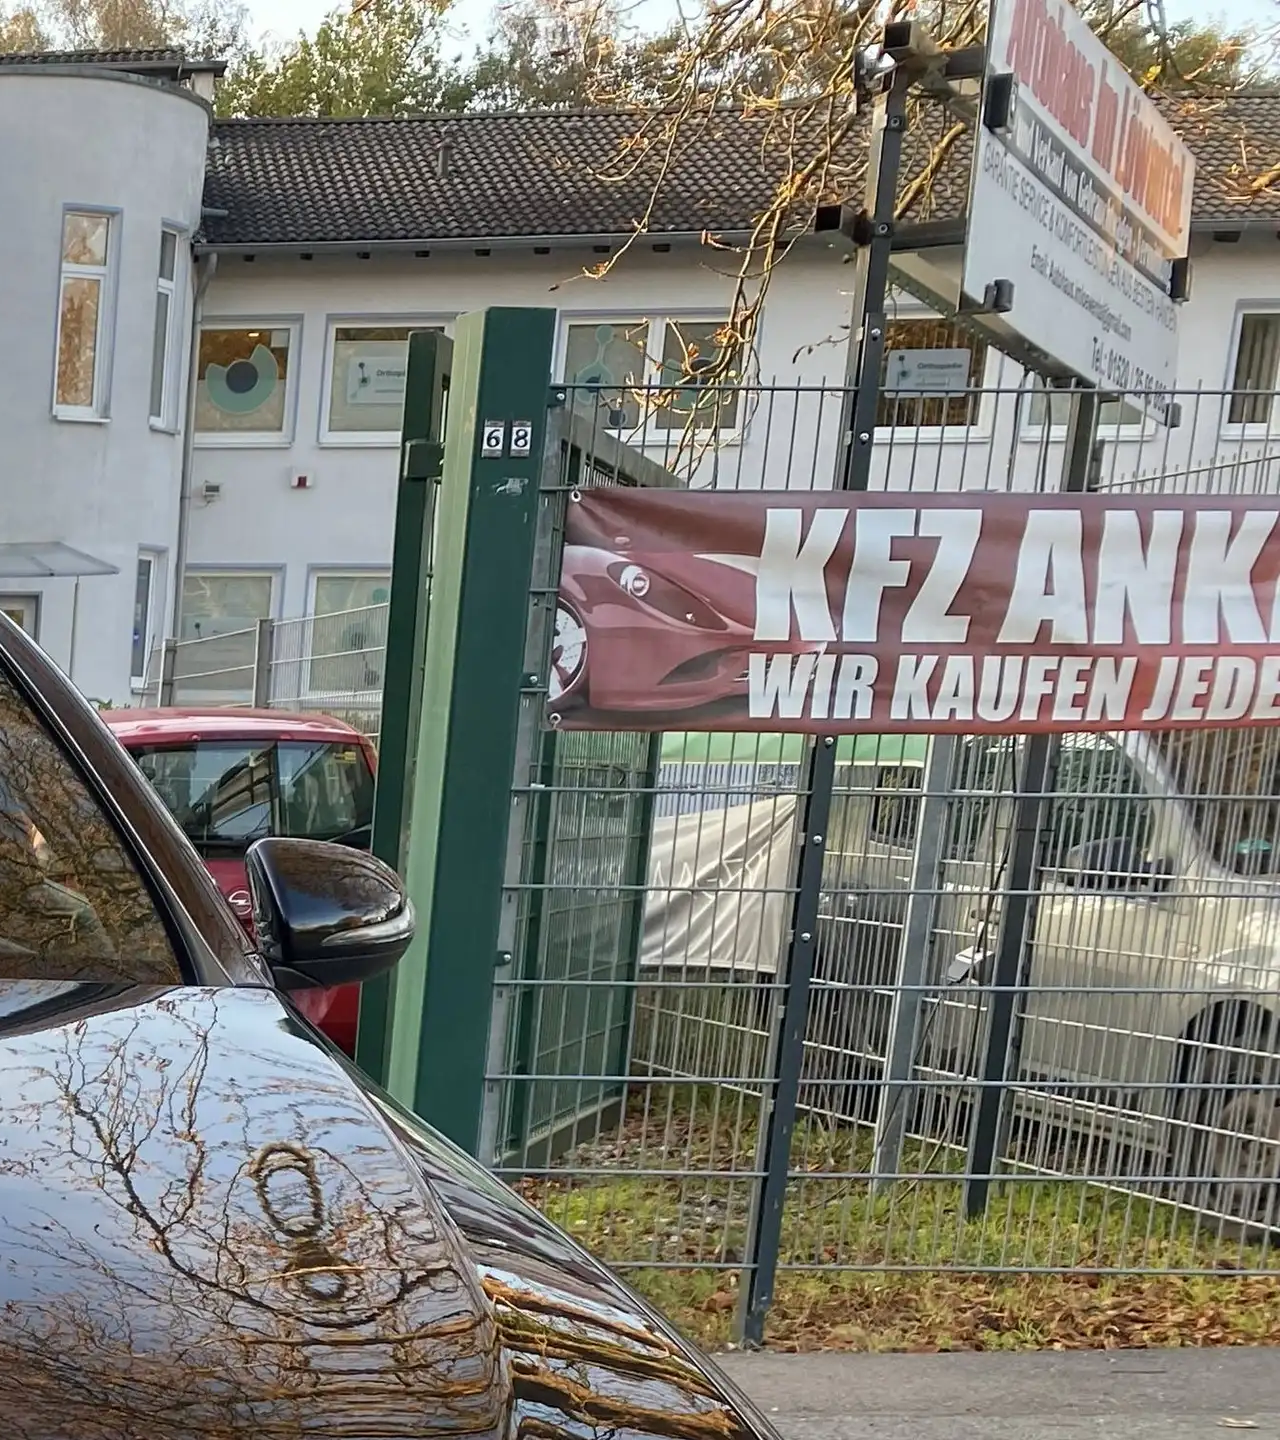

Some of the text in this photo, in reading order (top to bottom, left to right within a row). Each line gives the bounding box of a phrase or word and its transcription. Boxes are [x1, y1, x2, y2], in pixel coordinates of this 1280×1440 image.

[752, 507, 1280, 645] KFZ ANK
[748, 652, 879, 721] WIR
[889, 653, 1139, 722] KAUFEN
